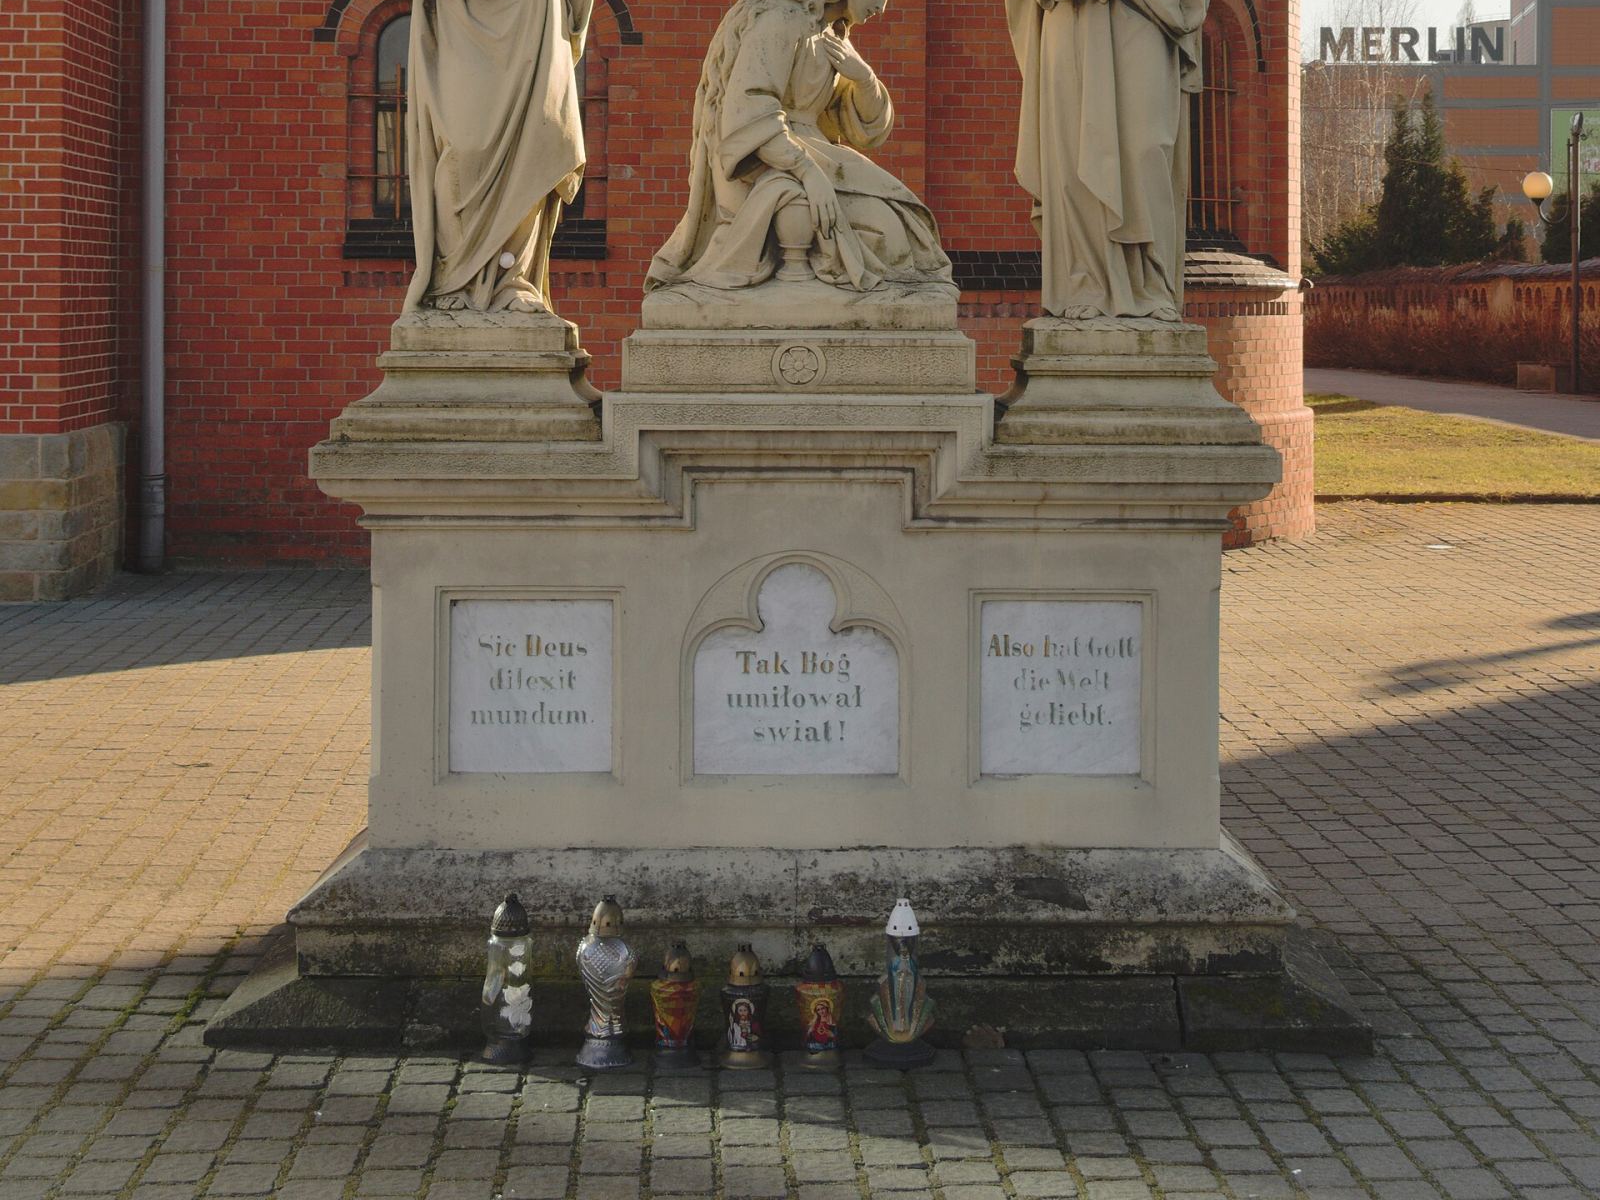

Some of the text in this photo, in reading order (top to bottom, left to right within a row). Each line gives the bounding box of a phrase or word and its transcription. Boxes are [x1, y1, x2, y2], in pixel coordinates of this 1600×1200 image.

[1319, 26, 1505, 62] MERLIN
[525, 633, 588, 657] Deus
[987, 634, 1137, 658] Also hat Gott
[735, 650, 850, 682] Tak Bóg
[489, 668, 576, 690] dilexit
[1013, 668, 1109, 691] die Welt
[726, 685, 863, 708] umiłował
[471, 701, 594, 725] mundum.
[1019, 702, 1112, 733] geliebt.
